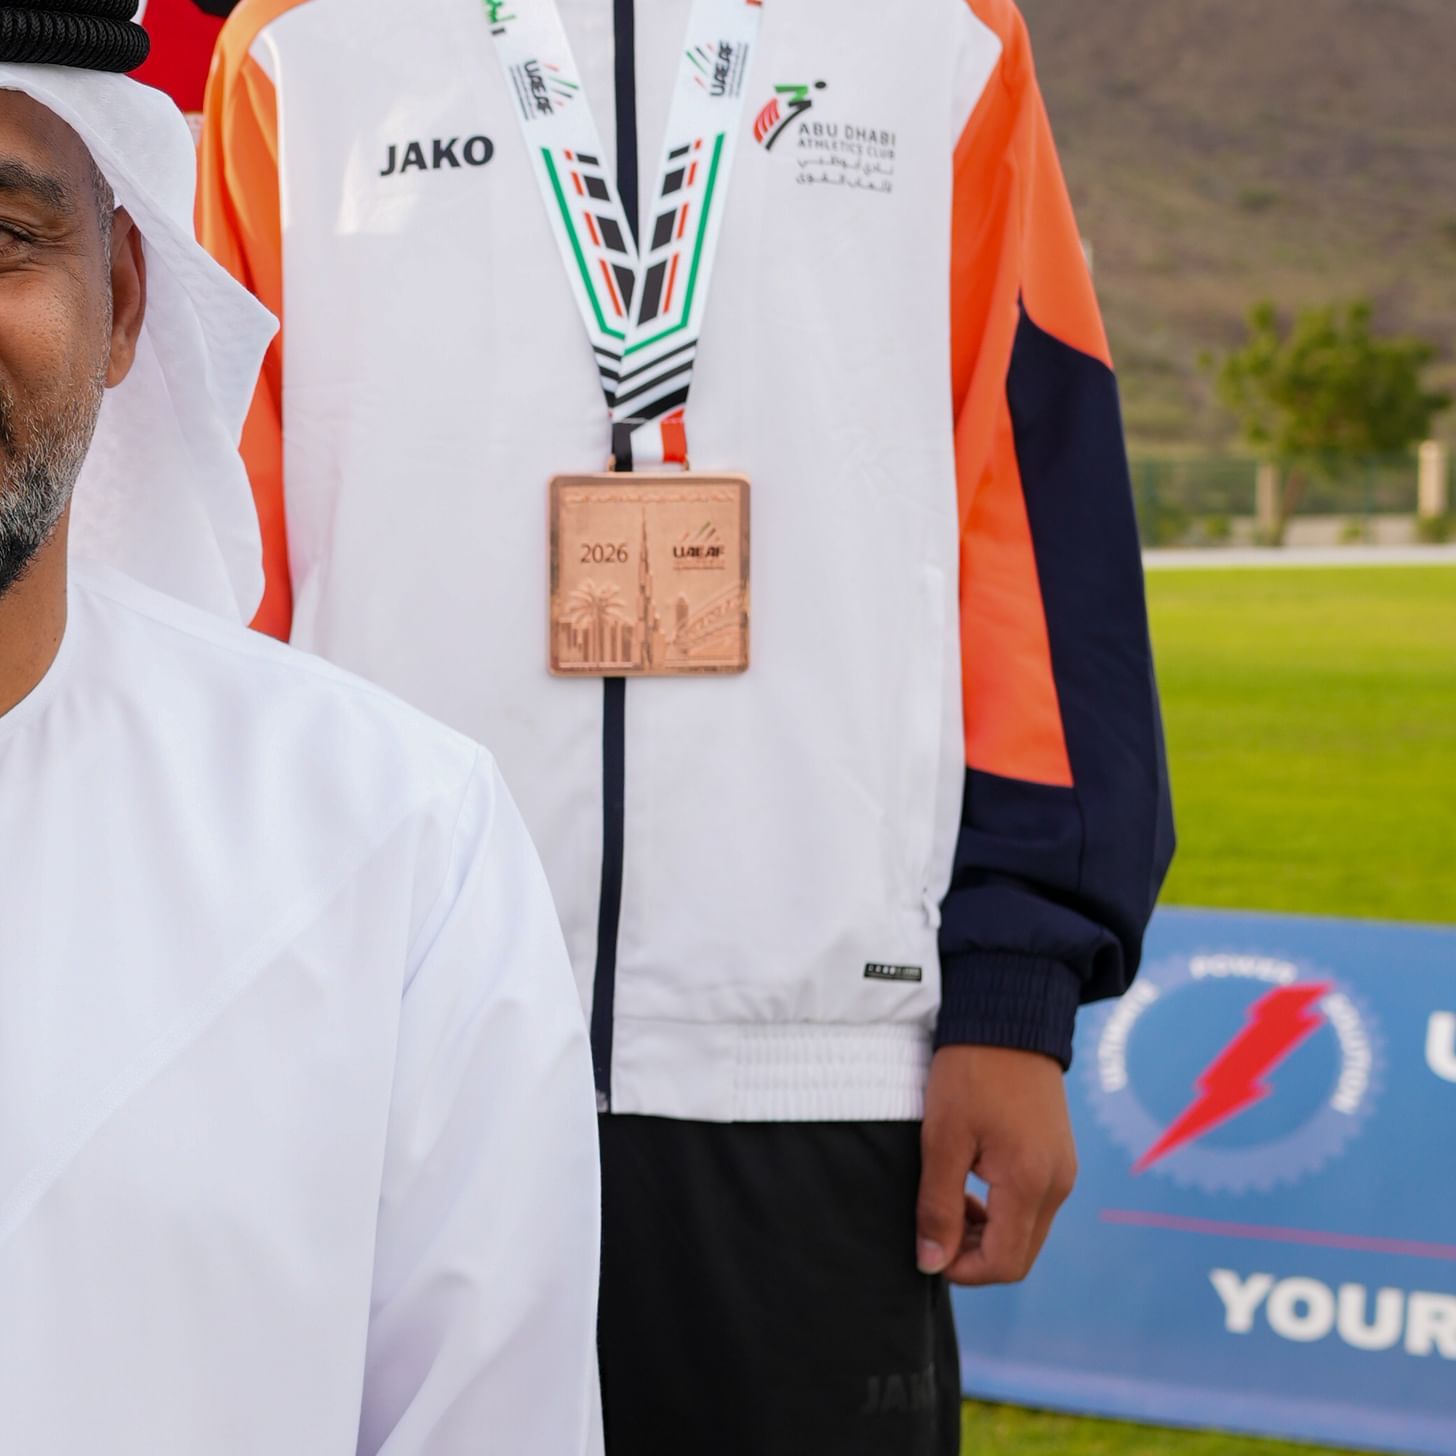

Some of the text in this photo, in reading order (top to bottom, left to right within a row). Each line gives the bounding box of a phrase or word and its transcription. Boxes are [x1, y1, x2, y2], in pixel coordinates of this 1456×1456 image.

[798, 121, 896, 147] ABU DHABI
[798, 138, 895, 159] ATHLETICS CLUB
[380, 135, 494, 176] JAKO
[580, 544, 628, 563] 2026
[1189, 953, 1298, 986] POWER
[1209, 1268, 1456, 1360] YOUR
